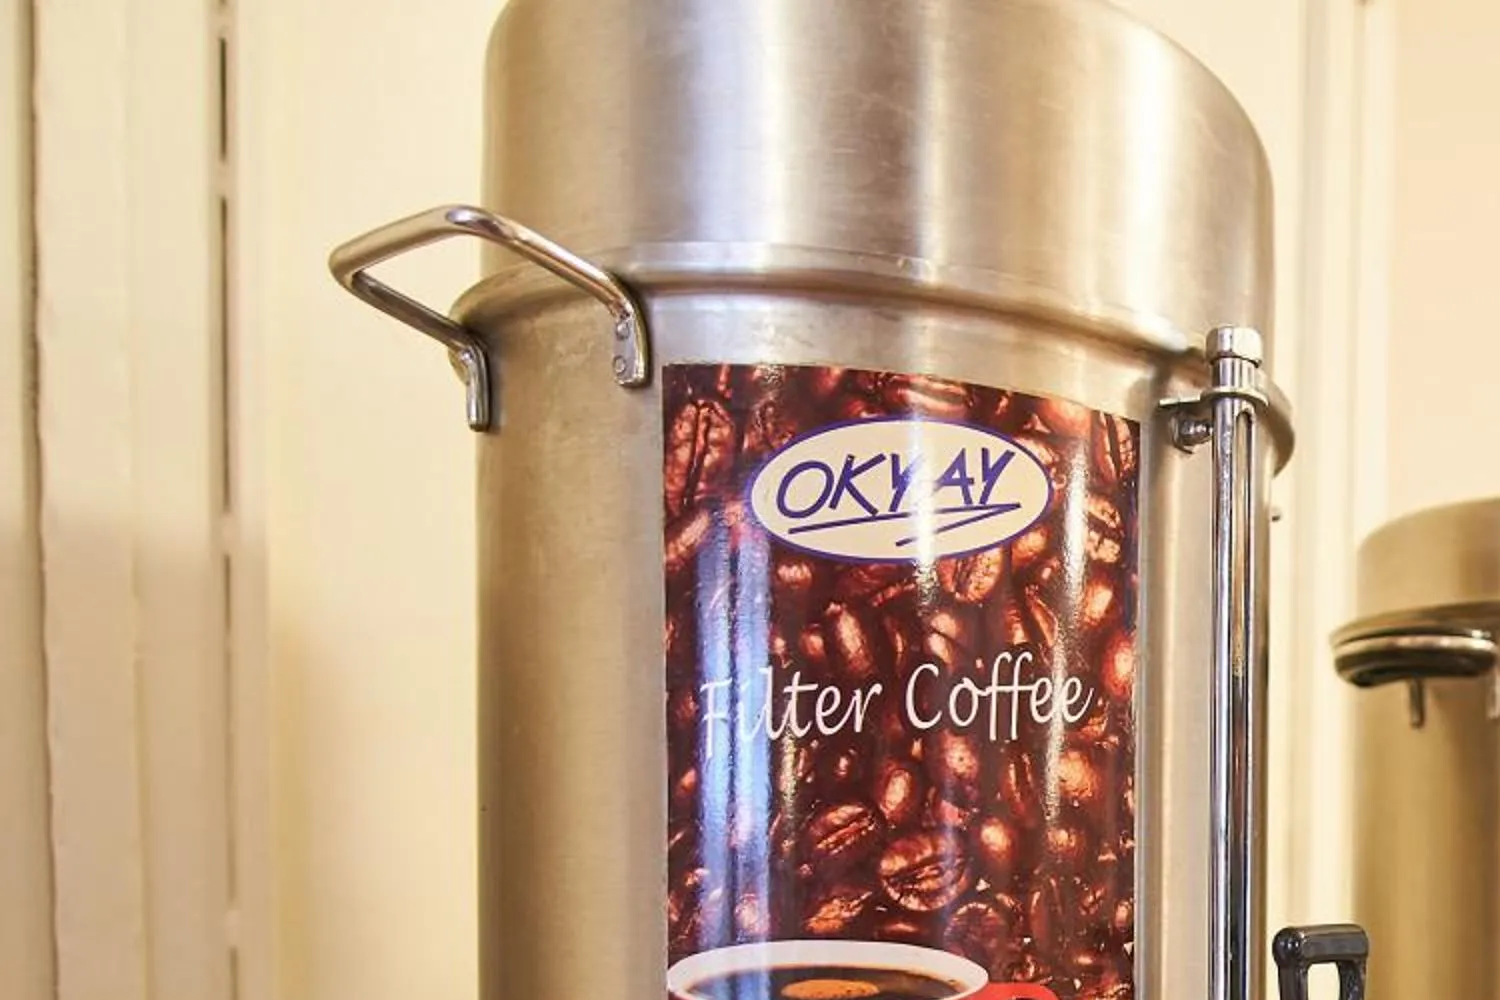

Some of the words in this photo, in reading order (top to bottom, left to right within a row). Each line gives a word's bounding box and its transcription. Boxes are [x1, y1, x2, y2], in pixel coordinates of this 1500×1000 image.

[776, 446, 1016, 519] OKYAY
[701, 667, 883, 758] Filter
[906, 651, 1095, 741] Coffee
